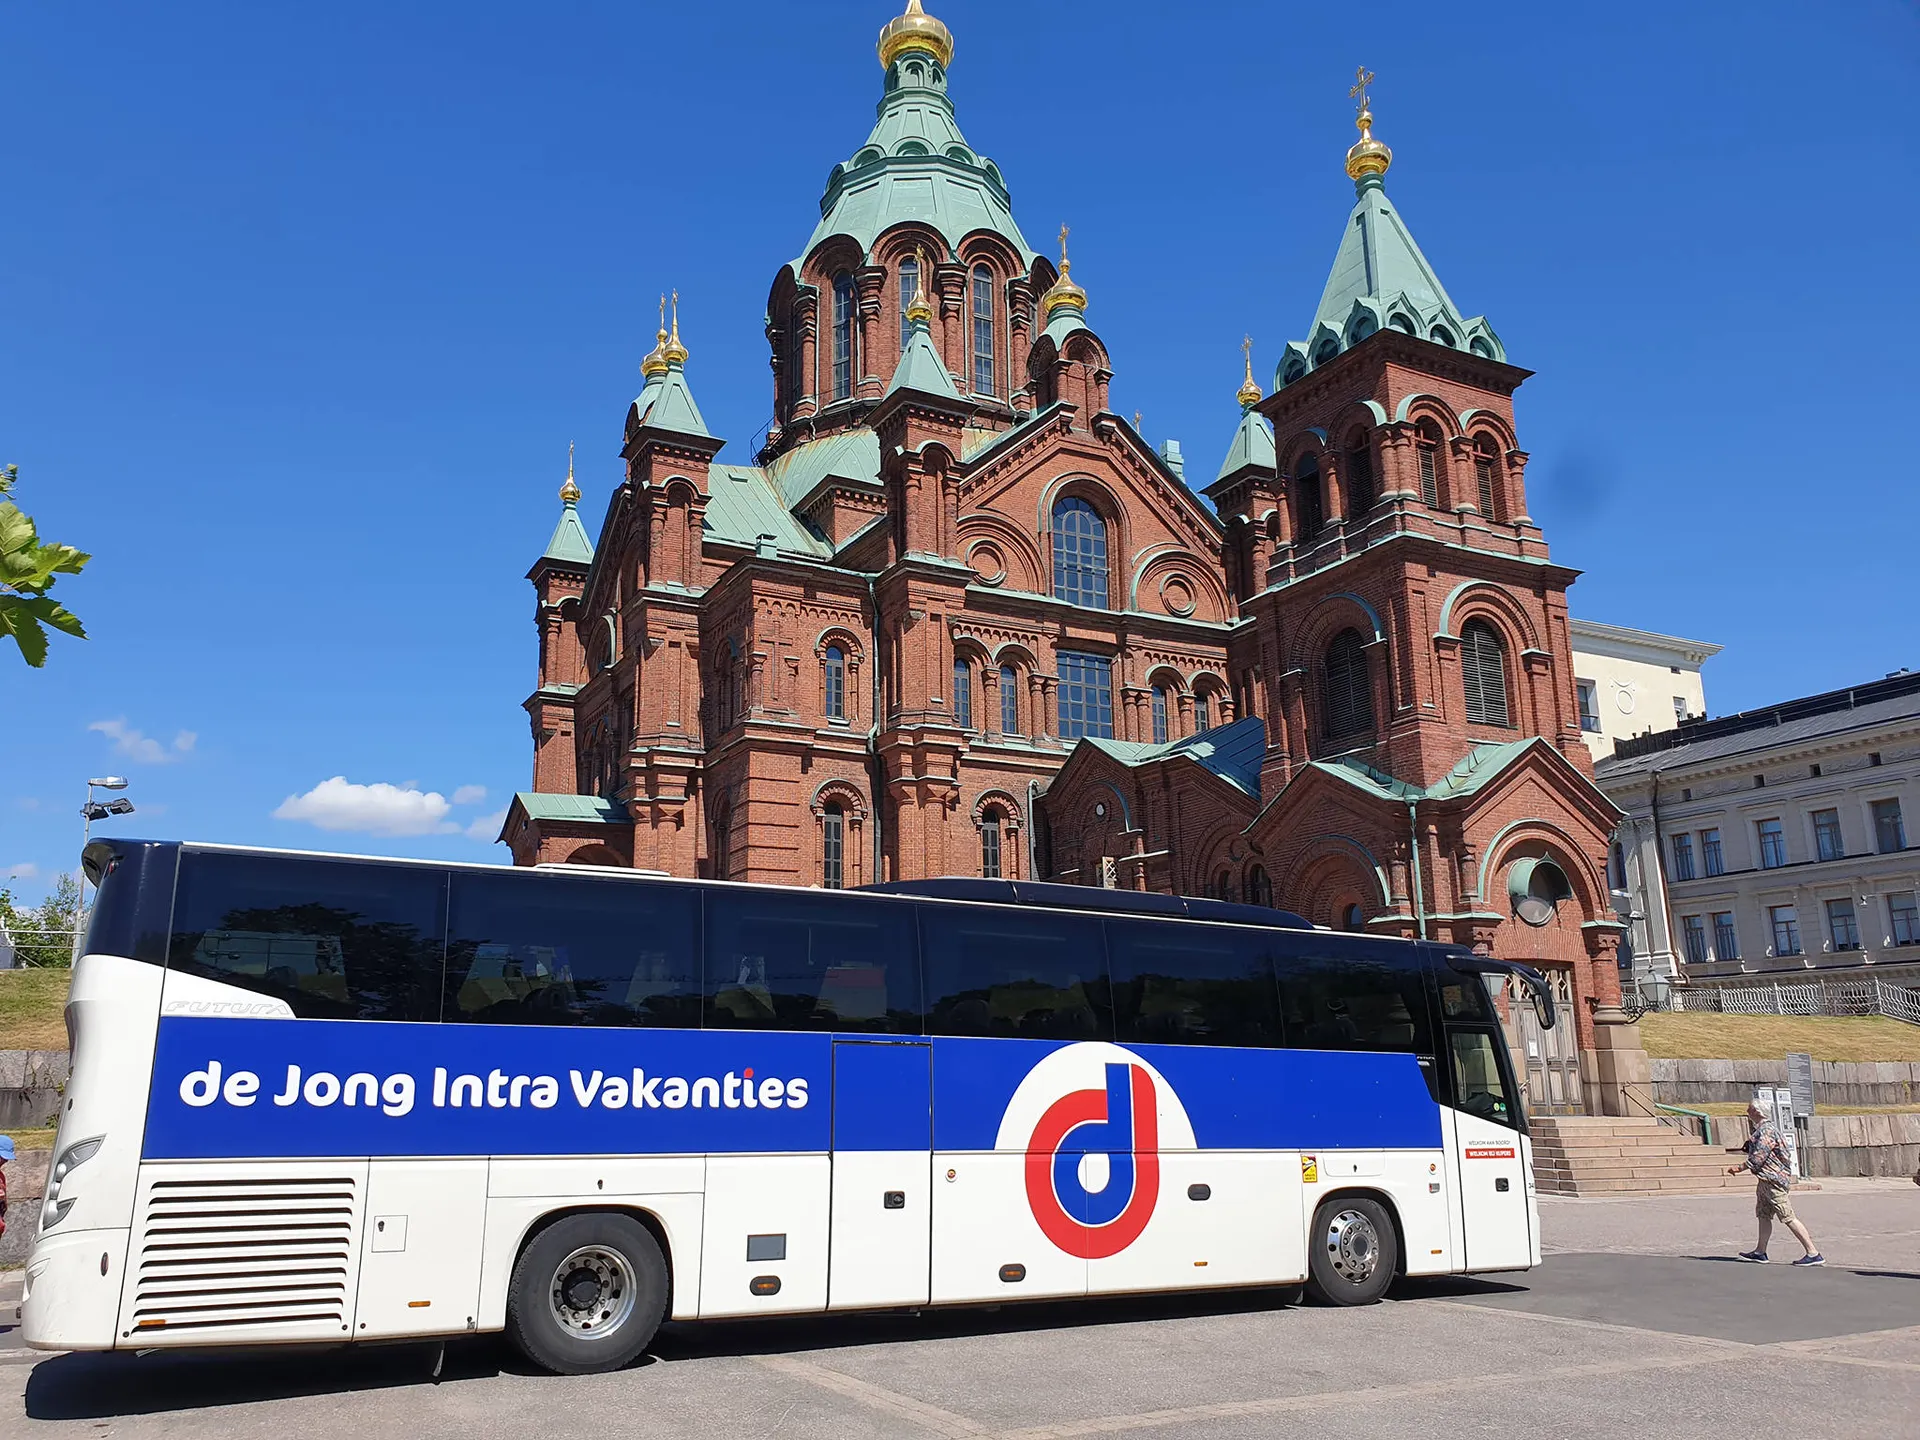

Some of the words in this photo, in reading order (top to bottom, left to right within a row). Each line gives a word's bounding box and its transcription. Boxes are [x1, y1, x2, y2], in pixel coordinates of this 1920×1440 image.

[180, 1061, 259, 1107] de
[274, 1065, 416, 1117] Jong
[433, 1068, 559, 1109] Intra
[570, 1068, 809, 1109] Vakanties
